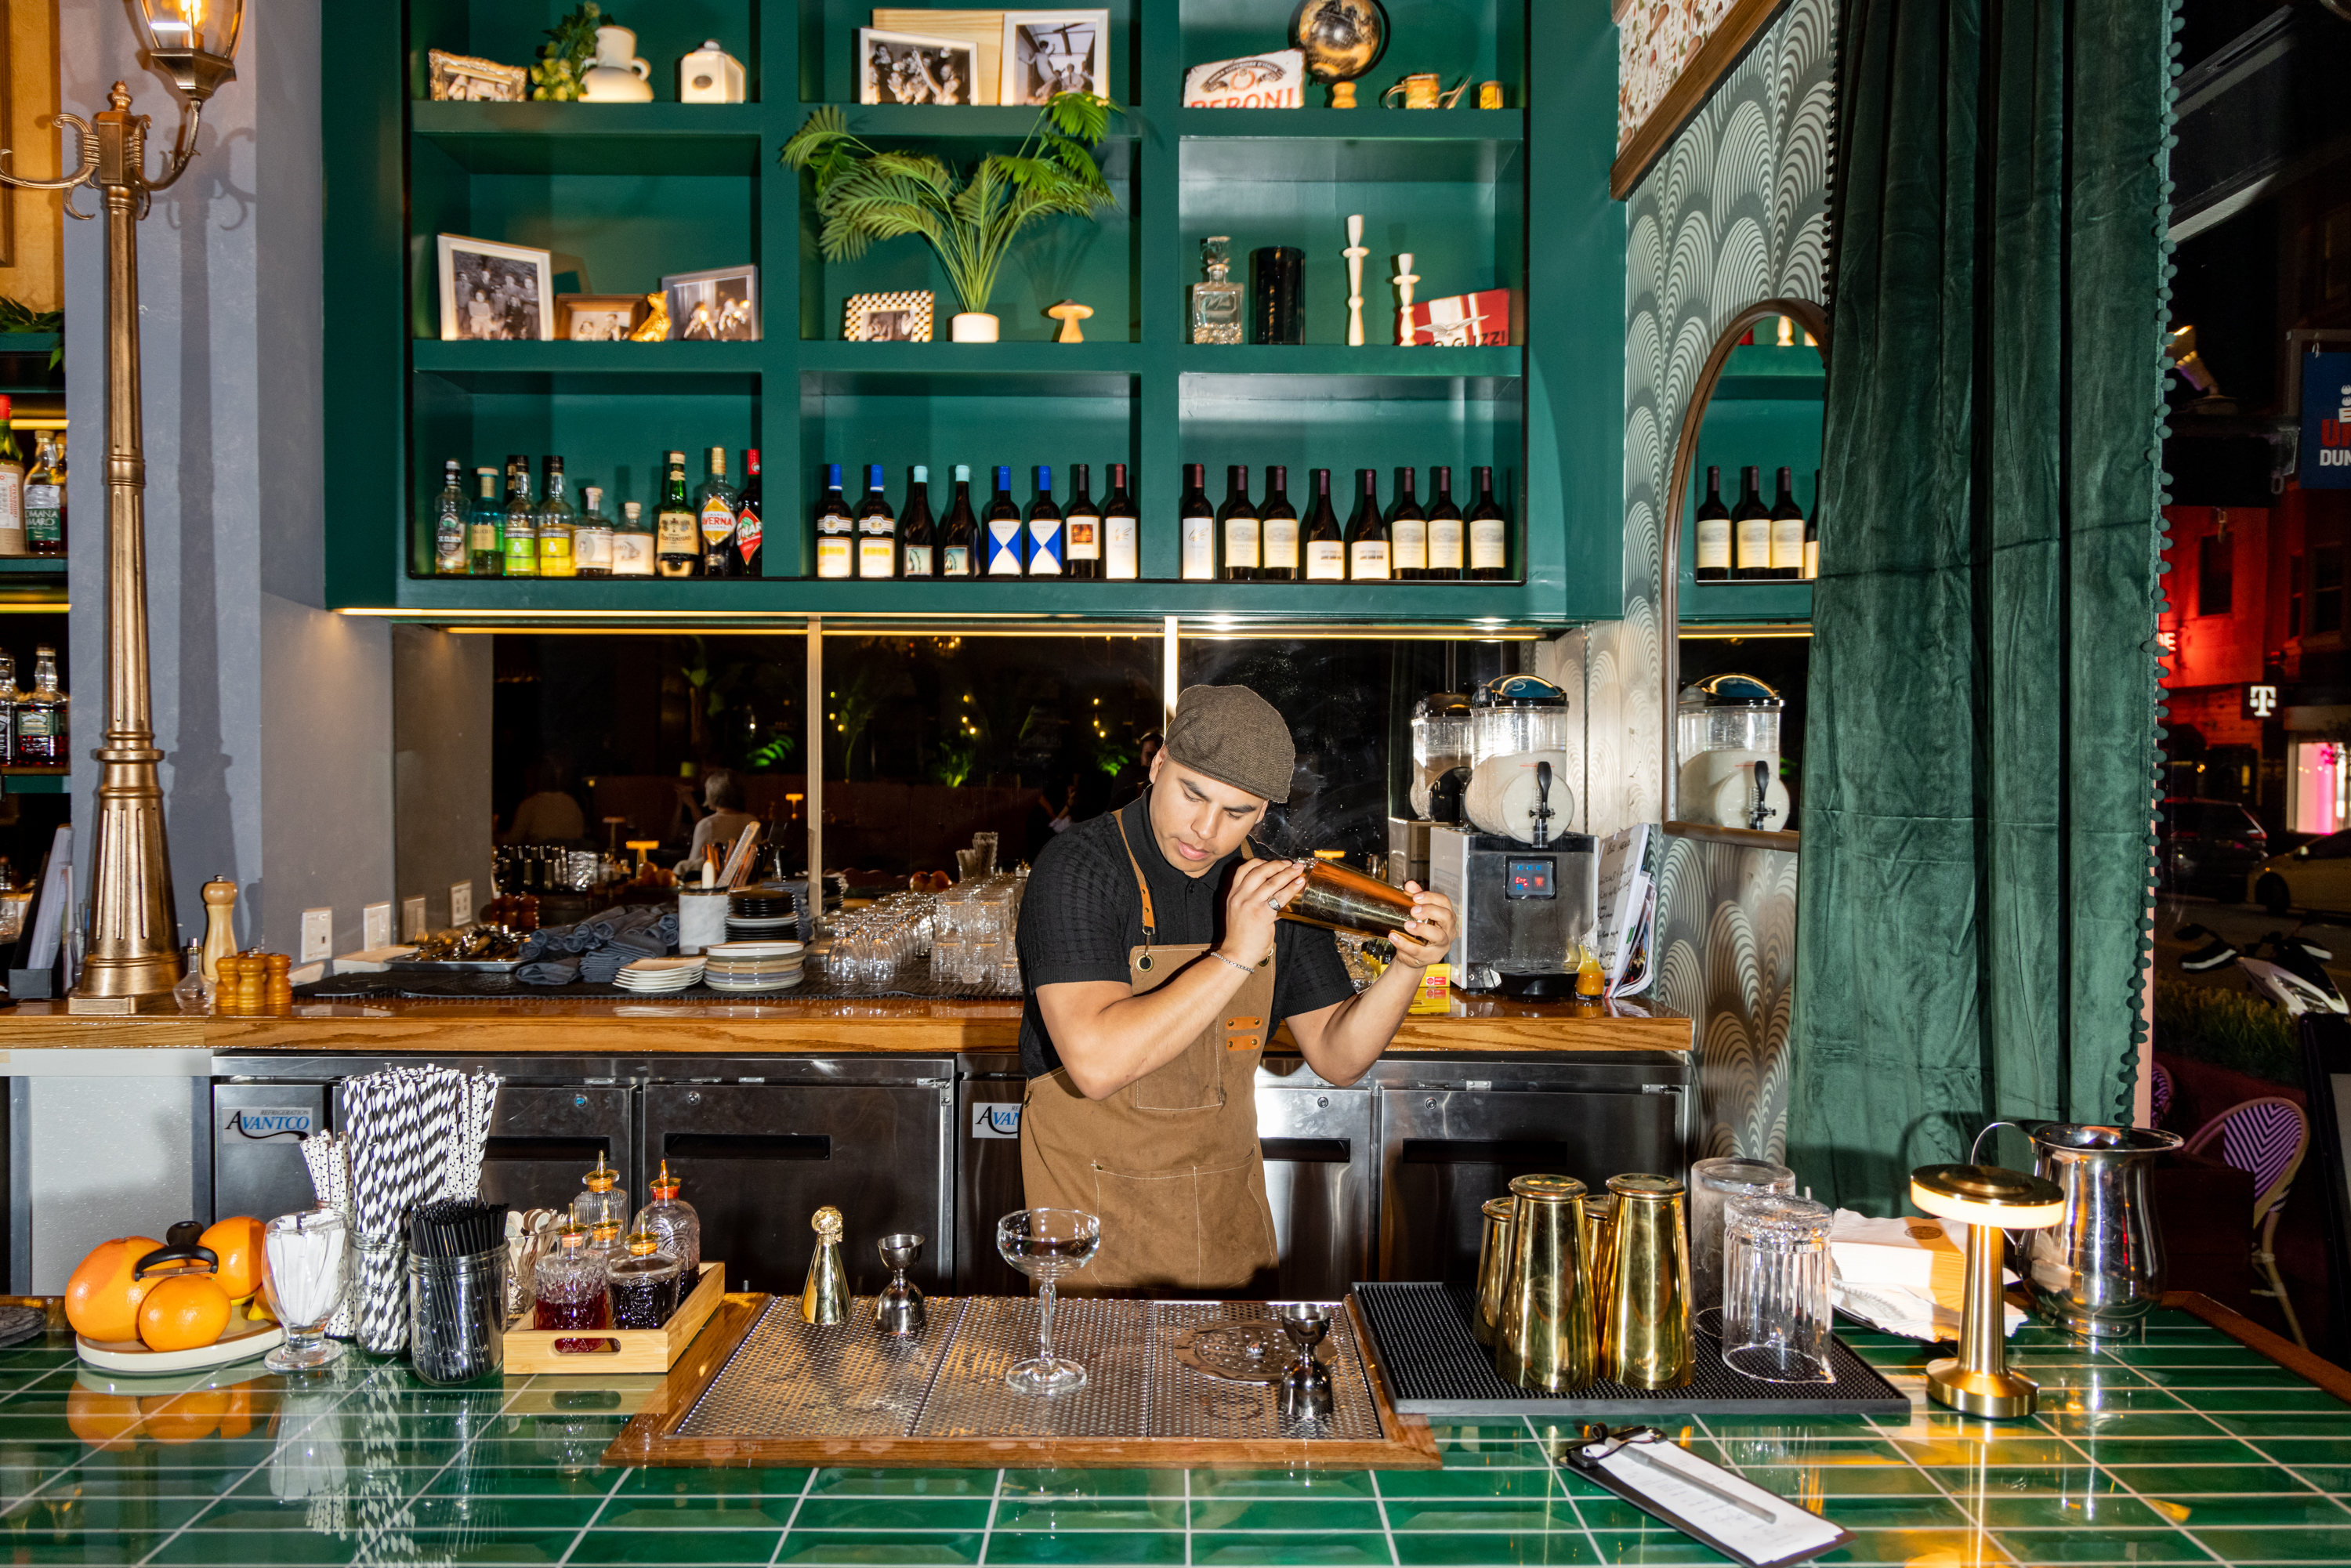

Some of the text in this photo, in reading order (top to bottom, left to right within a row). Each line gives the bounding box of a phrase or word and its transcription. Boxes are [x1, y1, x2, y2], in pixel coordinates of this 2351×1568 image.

[1225, 62, 1256, 73] SUPERIORE
[702, 516, 733, 527] AVERNA
[2249, 685, 2277, 717] T
[223, 1110, 310, 1133] AVANTCO
